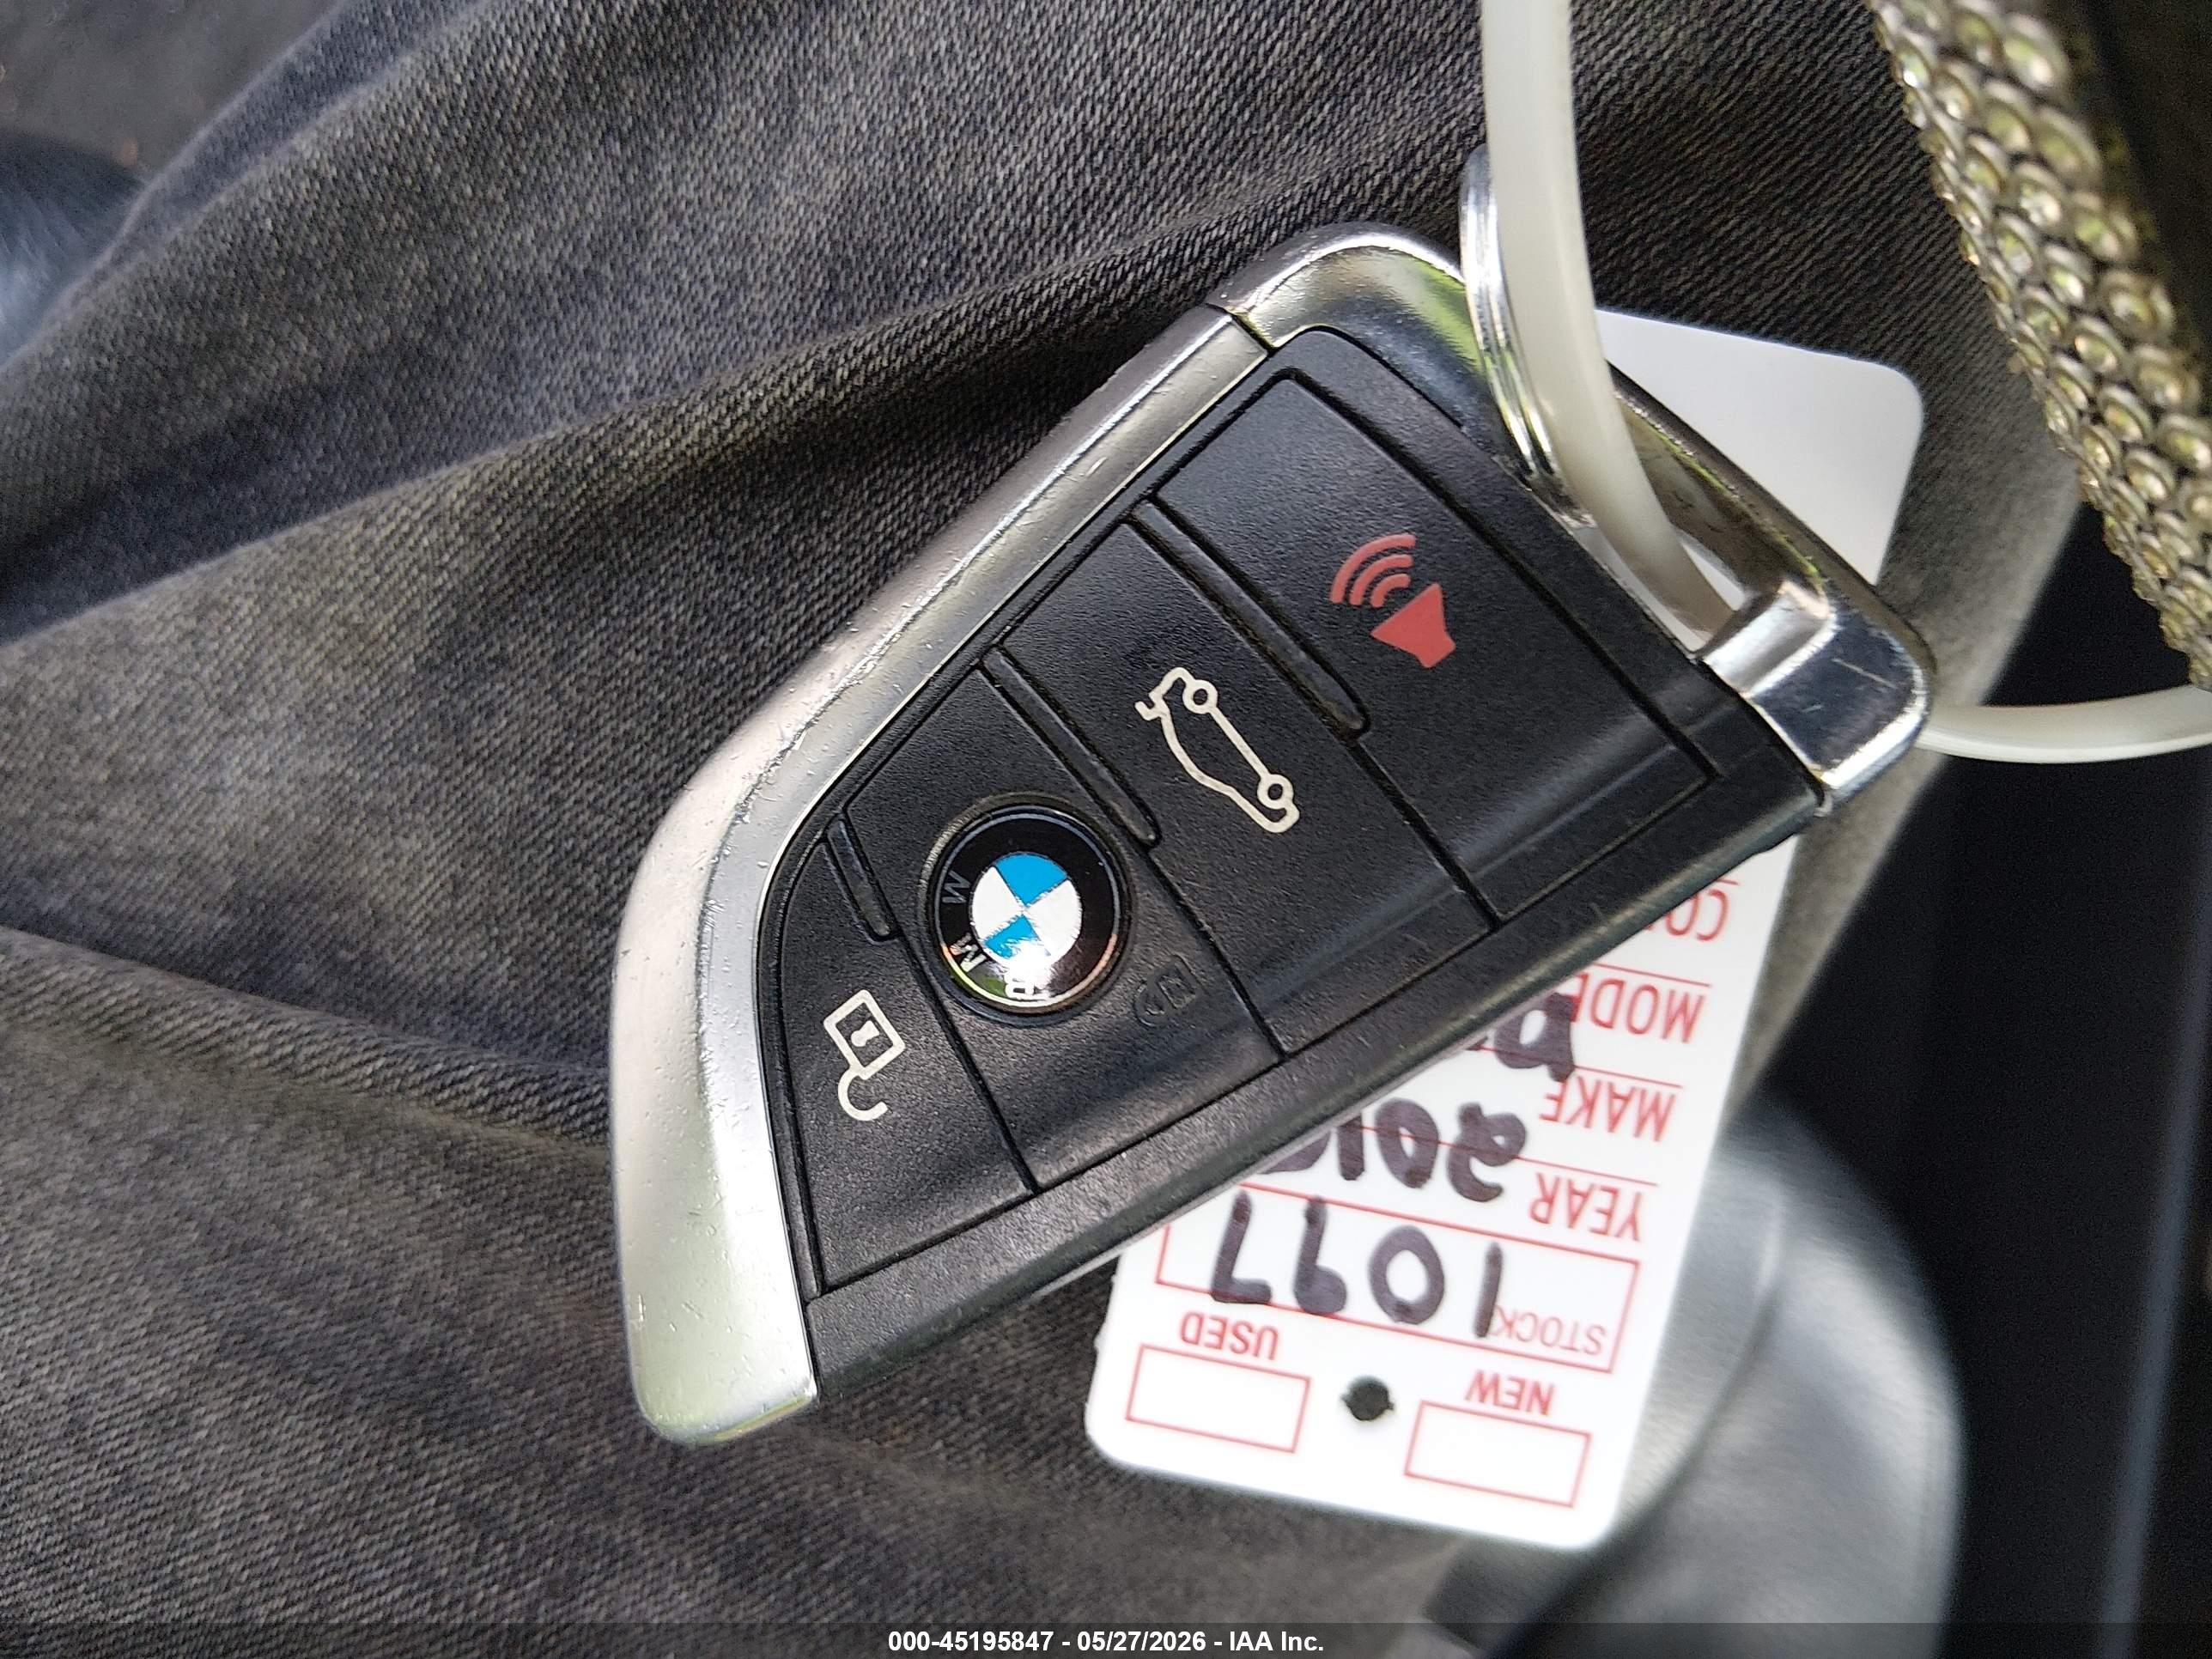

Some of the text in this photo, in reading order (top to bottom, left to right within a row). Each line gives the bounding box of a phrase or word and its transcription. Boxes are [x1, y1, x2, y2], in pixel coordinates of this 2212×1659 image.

[1644, 890, 1729, 941] CO
[1539, 1075, 1676, 1142] MAKE
[1260, 1097, 1527, 1203] 201
[1528, 1170, 1641, 1243] YEAR
[1211, 1190, 1504, 1339] 1097
[1179, 1310, 1279, 1360] USED
[1494, 1304, 1608, 1356] STOCK
[1465, 1369, 1555, 1416] NEW
